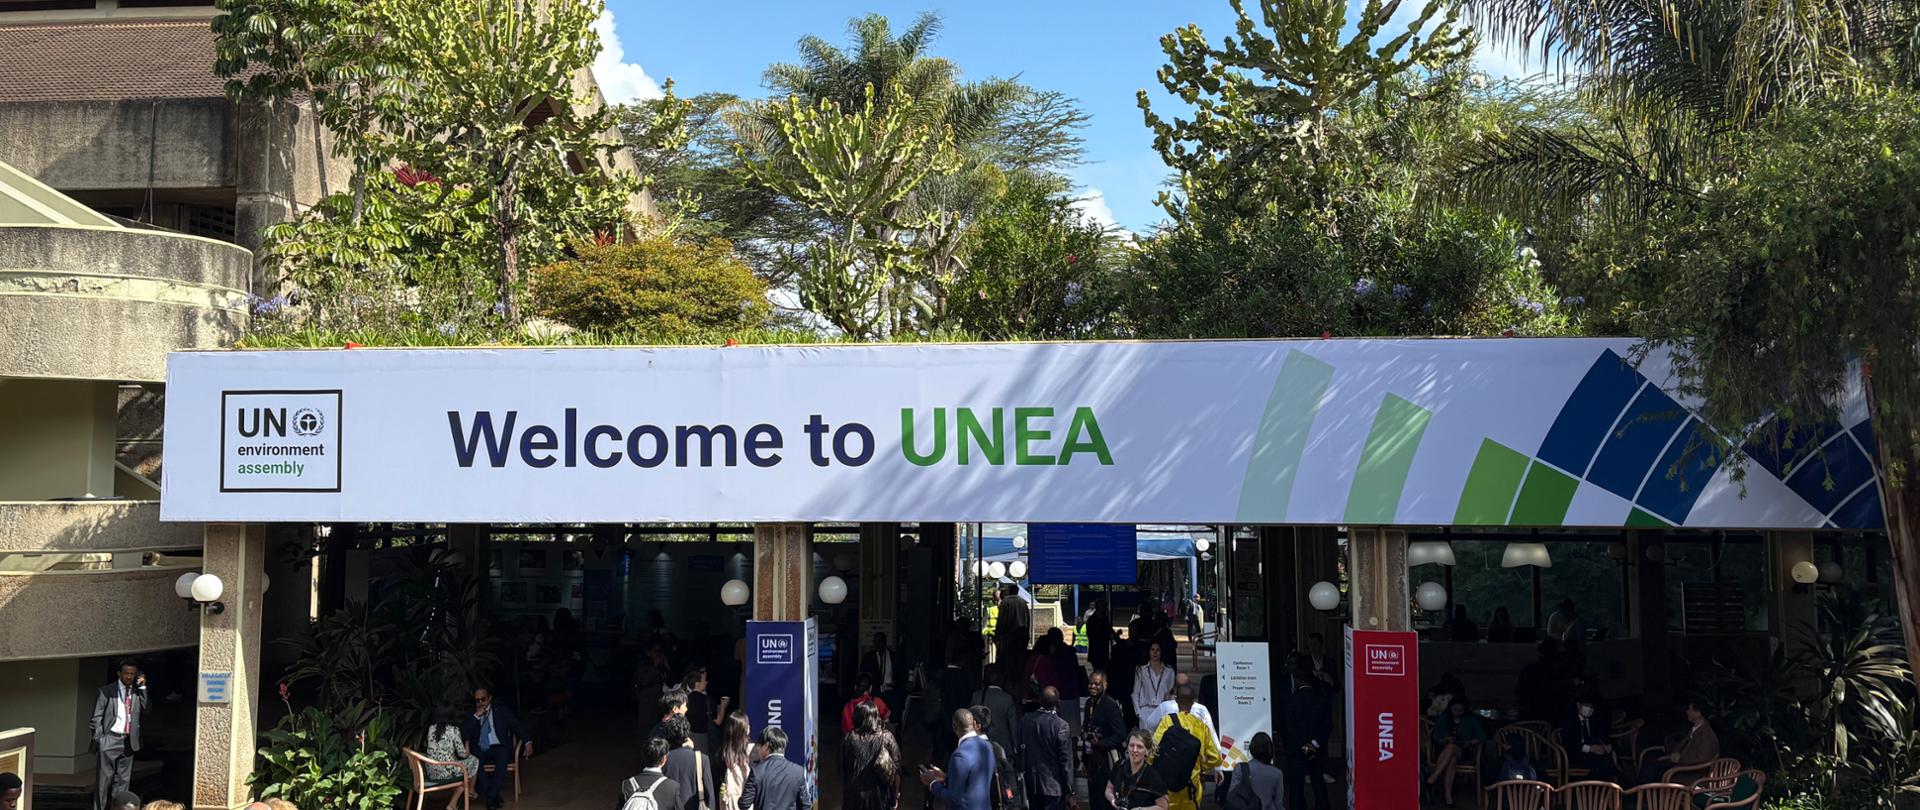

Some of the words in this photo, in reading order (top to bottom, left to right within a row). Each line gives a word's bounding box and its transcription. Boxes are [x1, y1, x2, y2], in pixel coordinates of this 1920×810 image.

[238, 408, 287, 437] UN
[447, 408, 784, 468] Welcome
[804, 414, 876, 467] to
[901, 407, 1115, 466] UNEA
[238, 443, 324, 456] environment
[238, 461, 304, 477] assembly
[762, 639, 777, 648] UN
[1371, 650, 1387, 659] UN
[1378, 712, 1394, 762] UNEA
